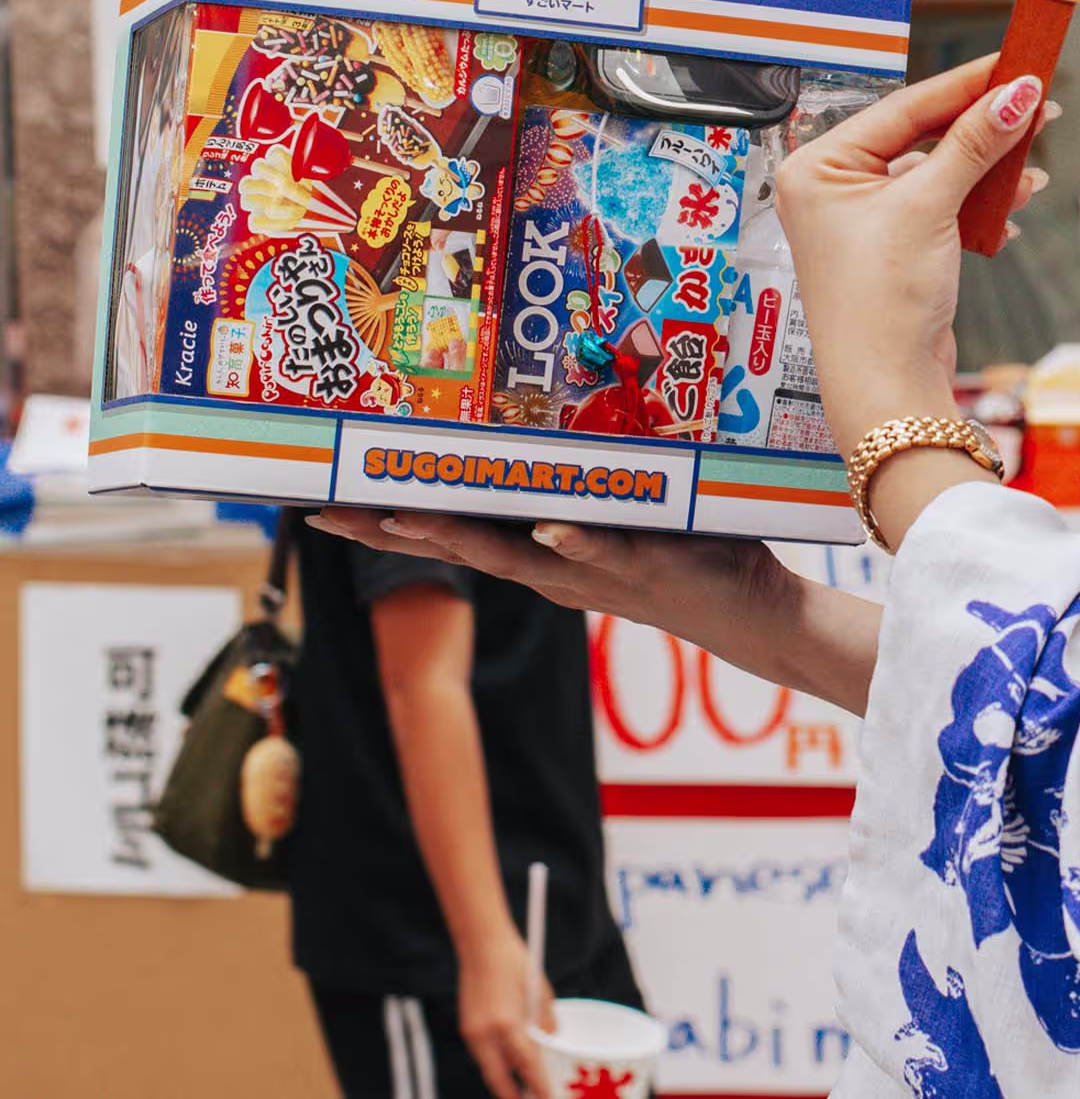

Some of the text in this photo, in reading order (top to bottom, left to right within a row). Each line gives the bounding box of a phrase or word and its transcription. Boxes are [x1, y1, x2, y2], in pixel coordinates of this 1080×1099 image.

[659, 135, 721, 175] ブルーハワイ
[508, 220, 569, 392] LOOK
[752, 292, 777, 372] ビー玉入り
[175, 320, 198, 387] Kracie
[225, 327, 246, 390] 知育菓子
[364, 447, 667, 502] SUGOIMART.COM
